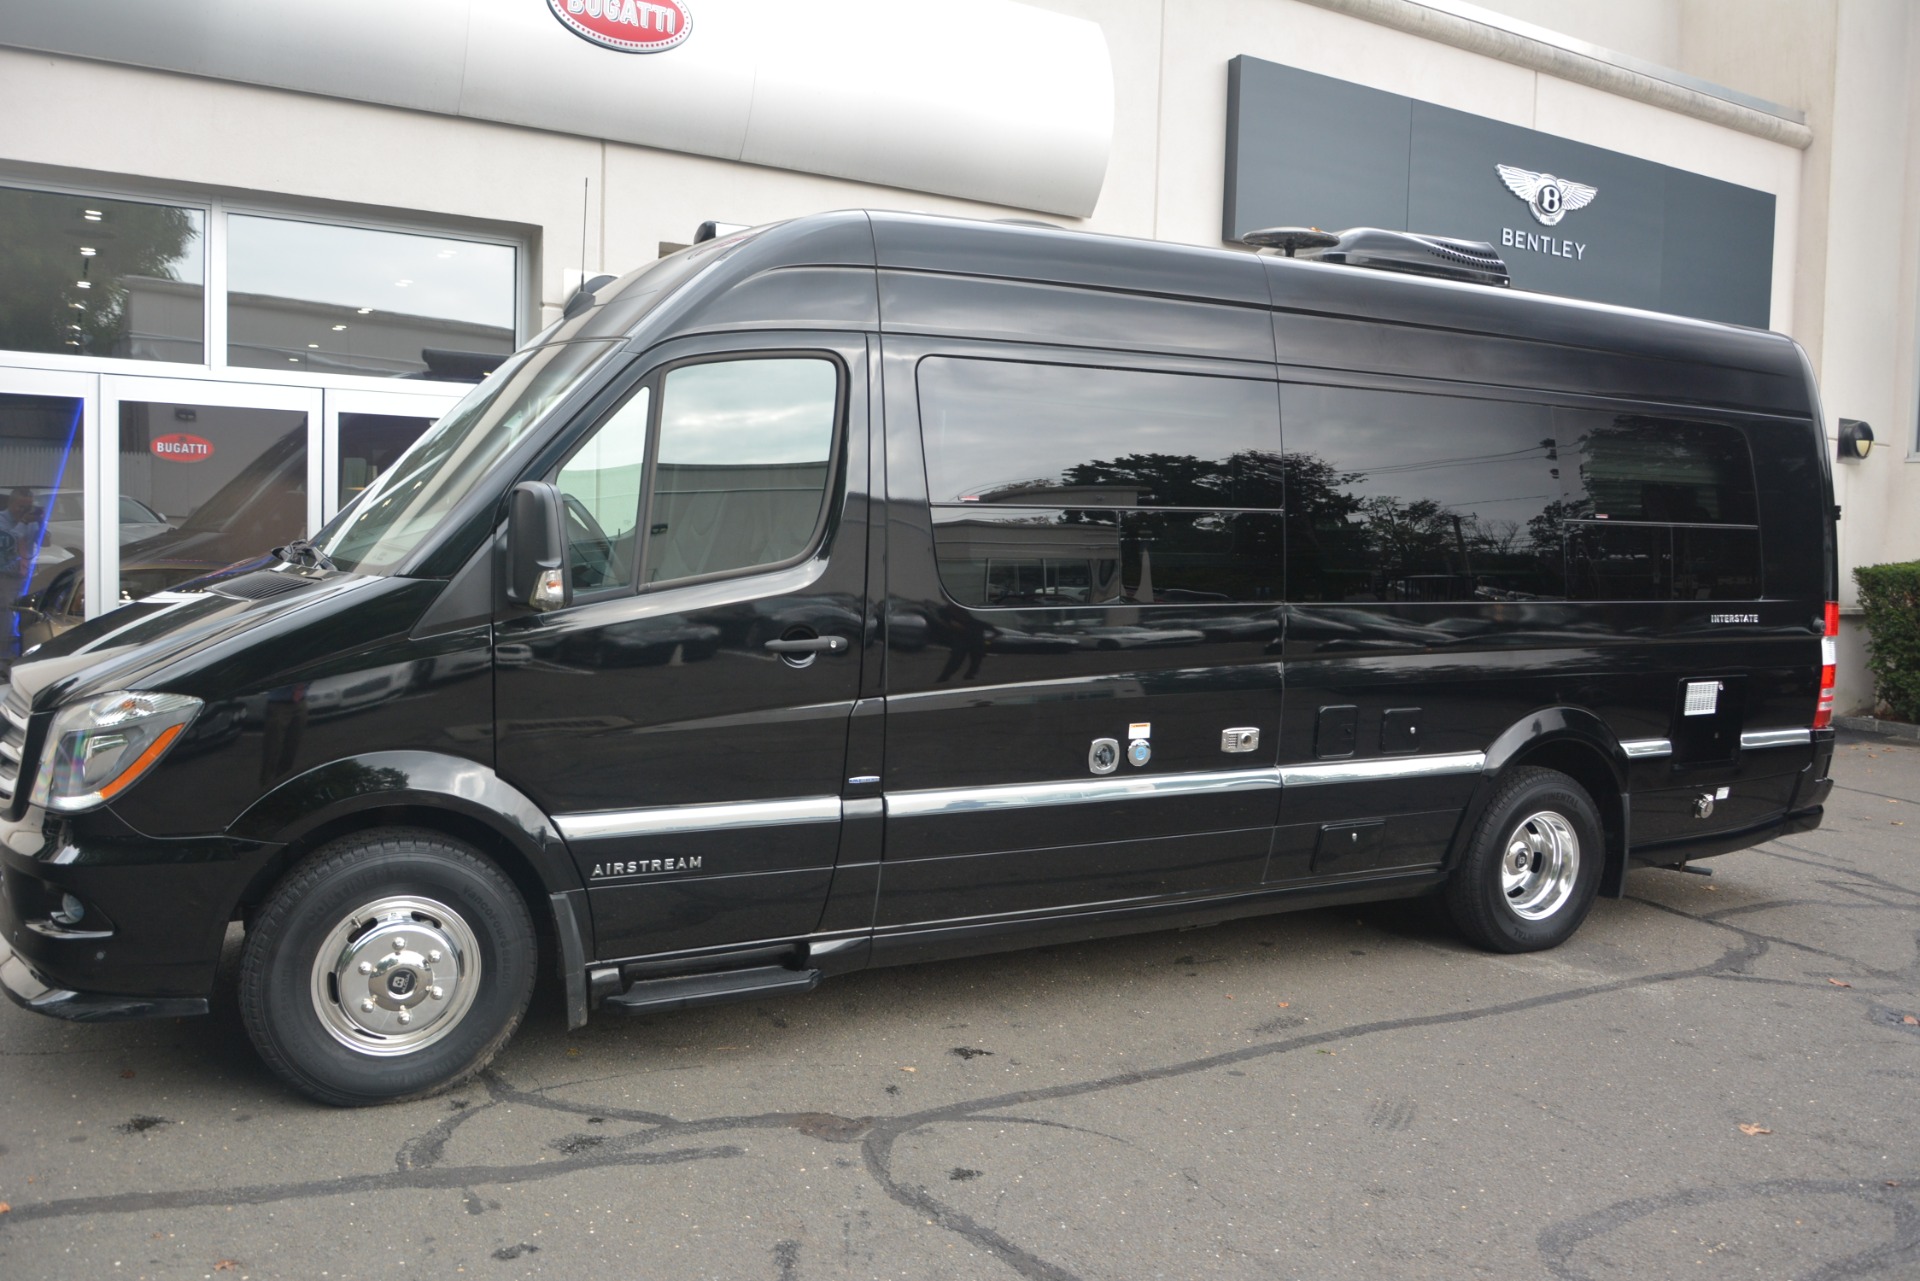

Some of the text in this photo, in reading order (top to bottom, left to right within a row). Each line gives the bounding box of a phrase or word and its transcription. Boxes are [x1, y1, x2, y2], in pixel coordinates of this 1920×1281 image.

[567, 0, 676, 34] BUGATTI
[1541, 187, 1561, 210] B
[1501, 227, 1586, 260] BENTLEY
[156, 442, 207, 454] BUGATTI
[1710, 614, 1759, 623] INTERSTATE
[591, 855, 702, 877] AIRSTREAM
